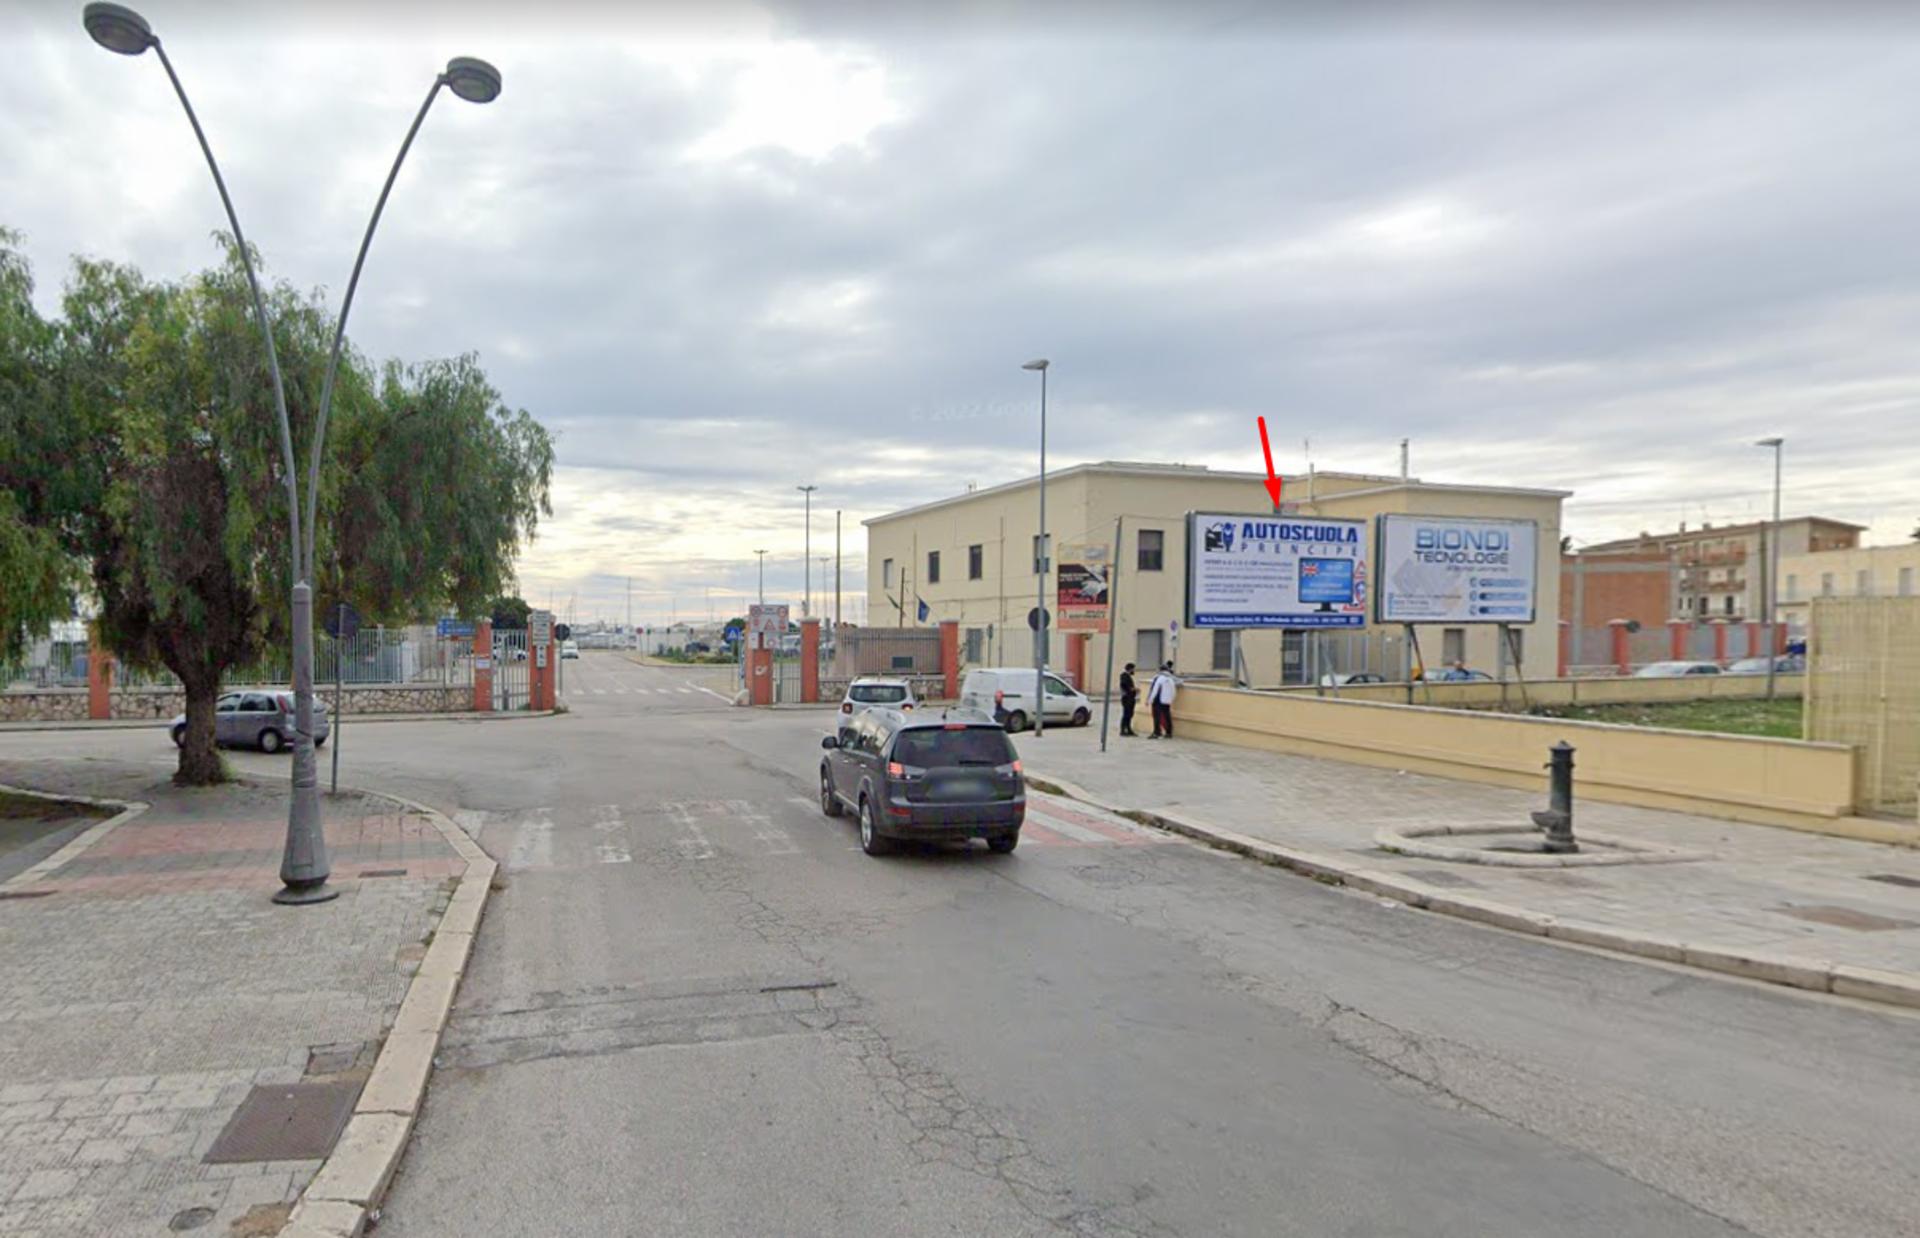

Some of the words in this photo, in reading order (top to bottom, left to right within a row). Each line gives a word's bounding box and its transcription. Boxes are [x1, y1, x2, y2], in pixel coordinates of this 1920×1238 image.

[1241, 522, 1358, 543] AUTOSCUOLA
[1416, 528, 1509, 551] BIONDI
[1414, 550, 1509, 565] TECNOLOGIE
